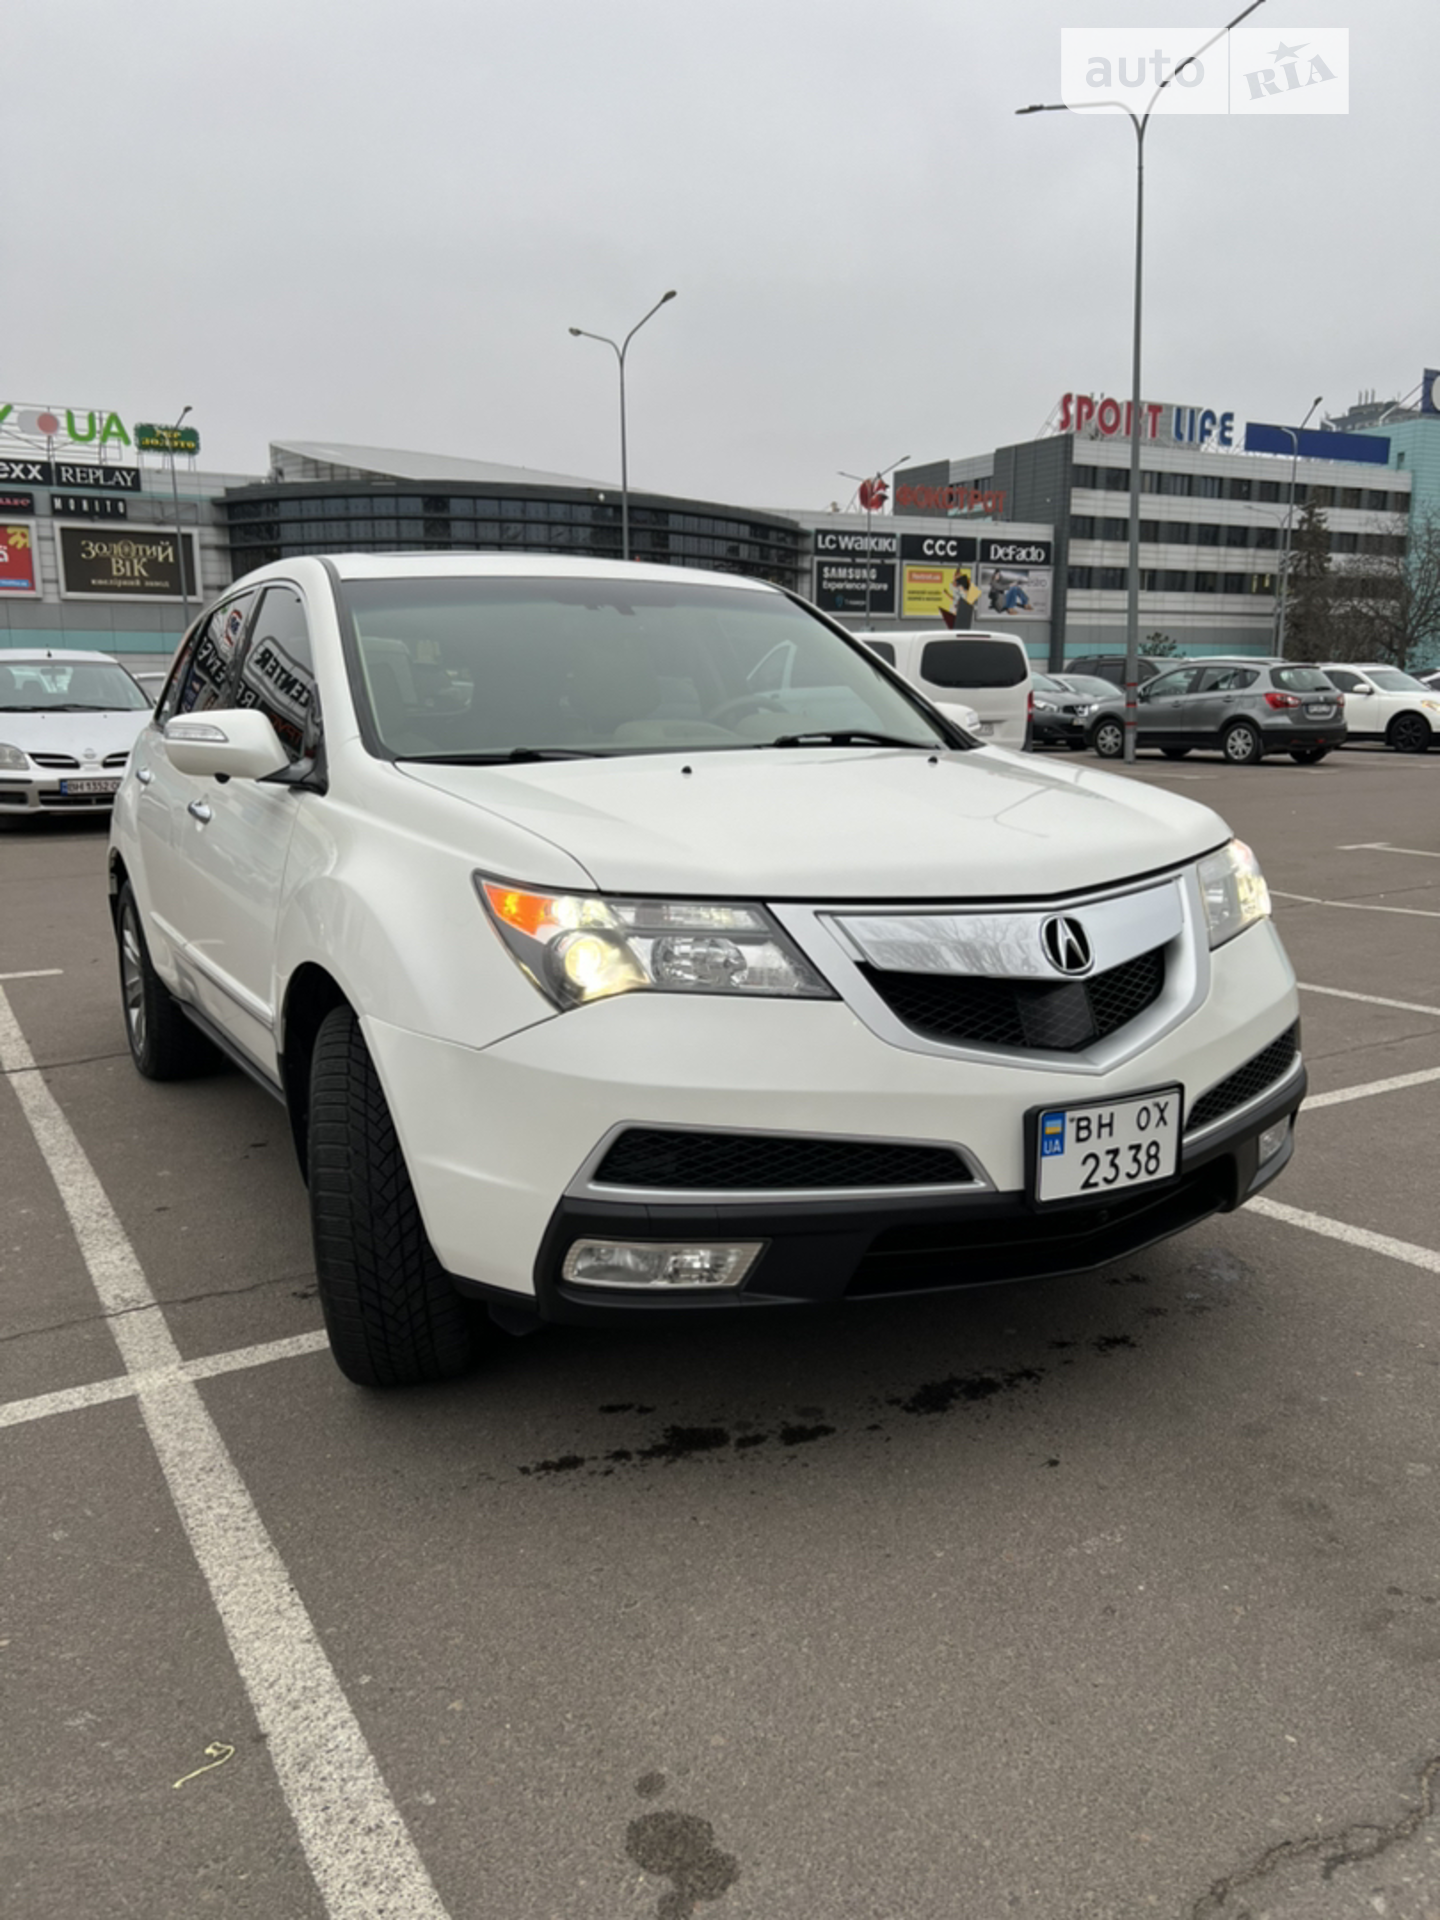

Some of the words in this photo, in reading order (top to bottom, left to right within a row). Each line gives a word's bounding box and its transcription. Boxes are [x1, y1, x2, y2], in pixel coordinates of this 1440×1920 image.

[66, 409, 131, 447] UA
[1059, 392, 1163, 440] SPORT
[1172, 406, 1235, 446] LIFE
[60, 466, 136, 487] REPLAY
[817, 534, 837, 550] LC
[923, 539, 958, 556] CCC
[989, 543, 1046, 563] DeFacto
[822, 566, 877, 580] SAMSUNG
[822, 580, 867, 592] Experience
[1075, 1112, 1114, 1143] BH
[1043, 1139, 1062, 1154] UA
[1080, 1140, 1160, 1190] 2338
